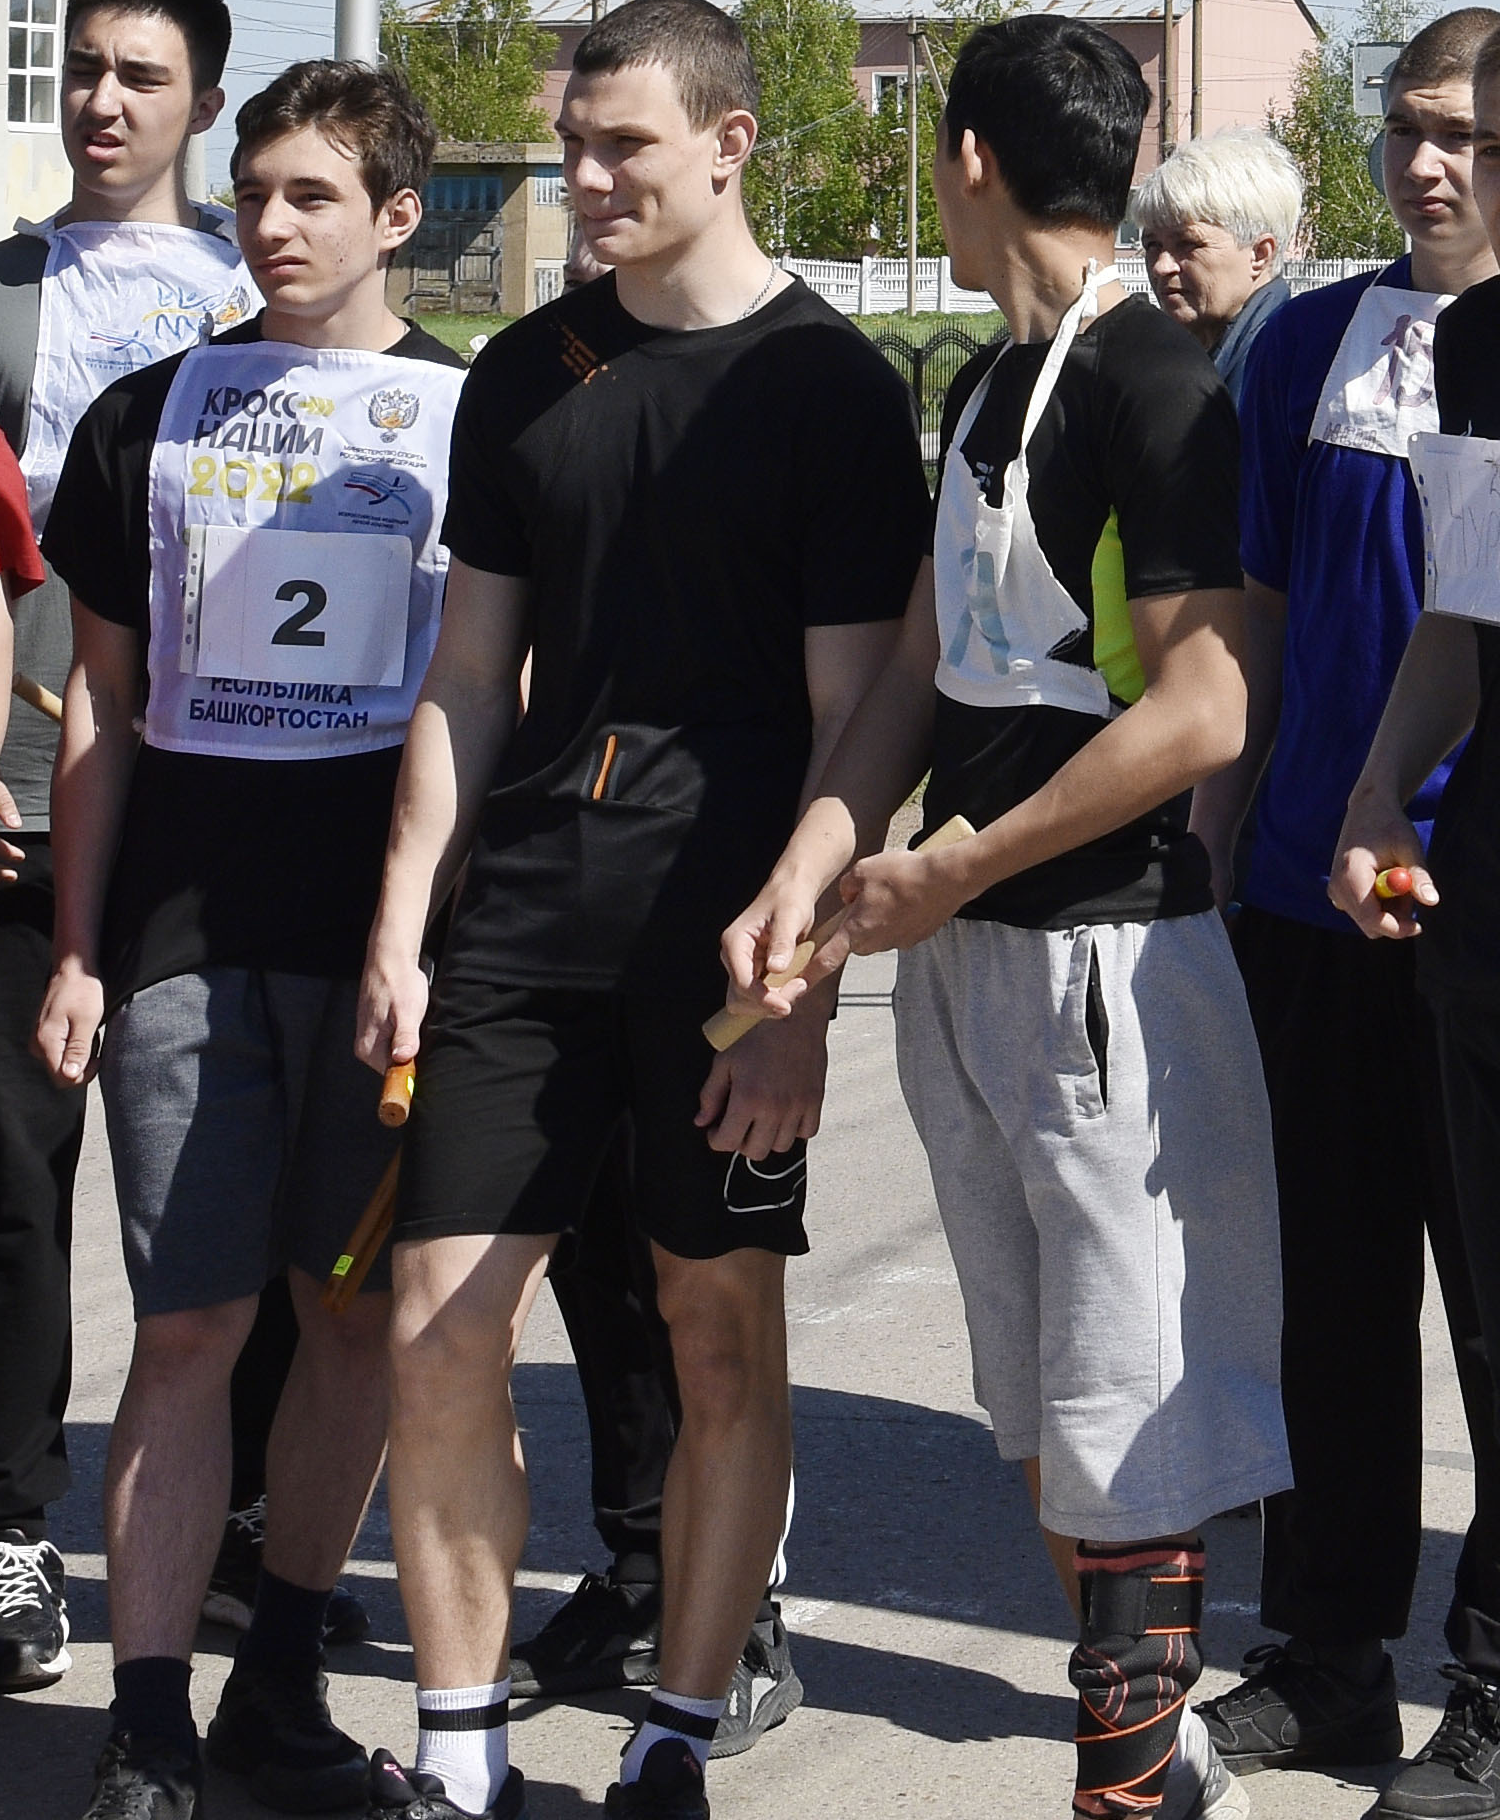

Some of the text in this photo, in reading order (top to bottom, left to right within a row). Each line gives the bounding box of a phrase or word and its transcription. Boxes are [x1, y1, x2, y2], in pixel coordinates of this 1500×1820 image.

[202, 386, 301, 419] КРОСС
[193, 419, 325, 458] НАЦИИ
[187, 455, 317, 504] 2022
[270, 579, 328, 648] 2
[189, 698, 369, 730] БАШКОРТОСТАН
